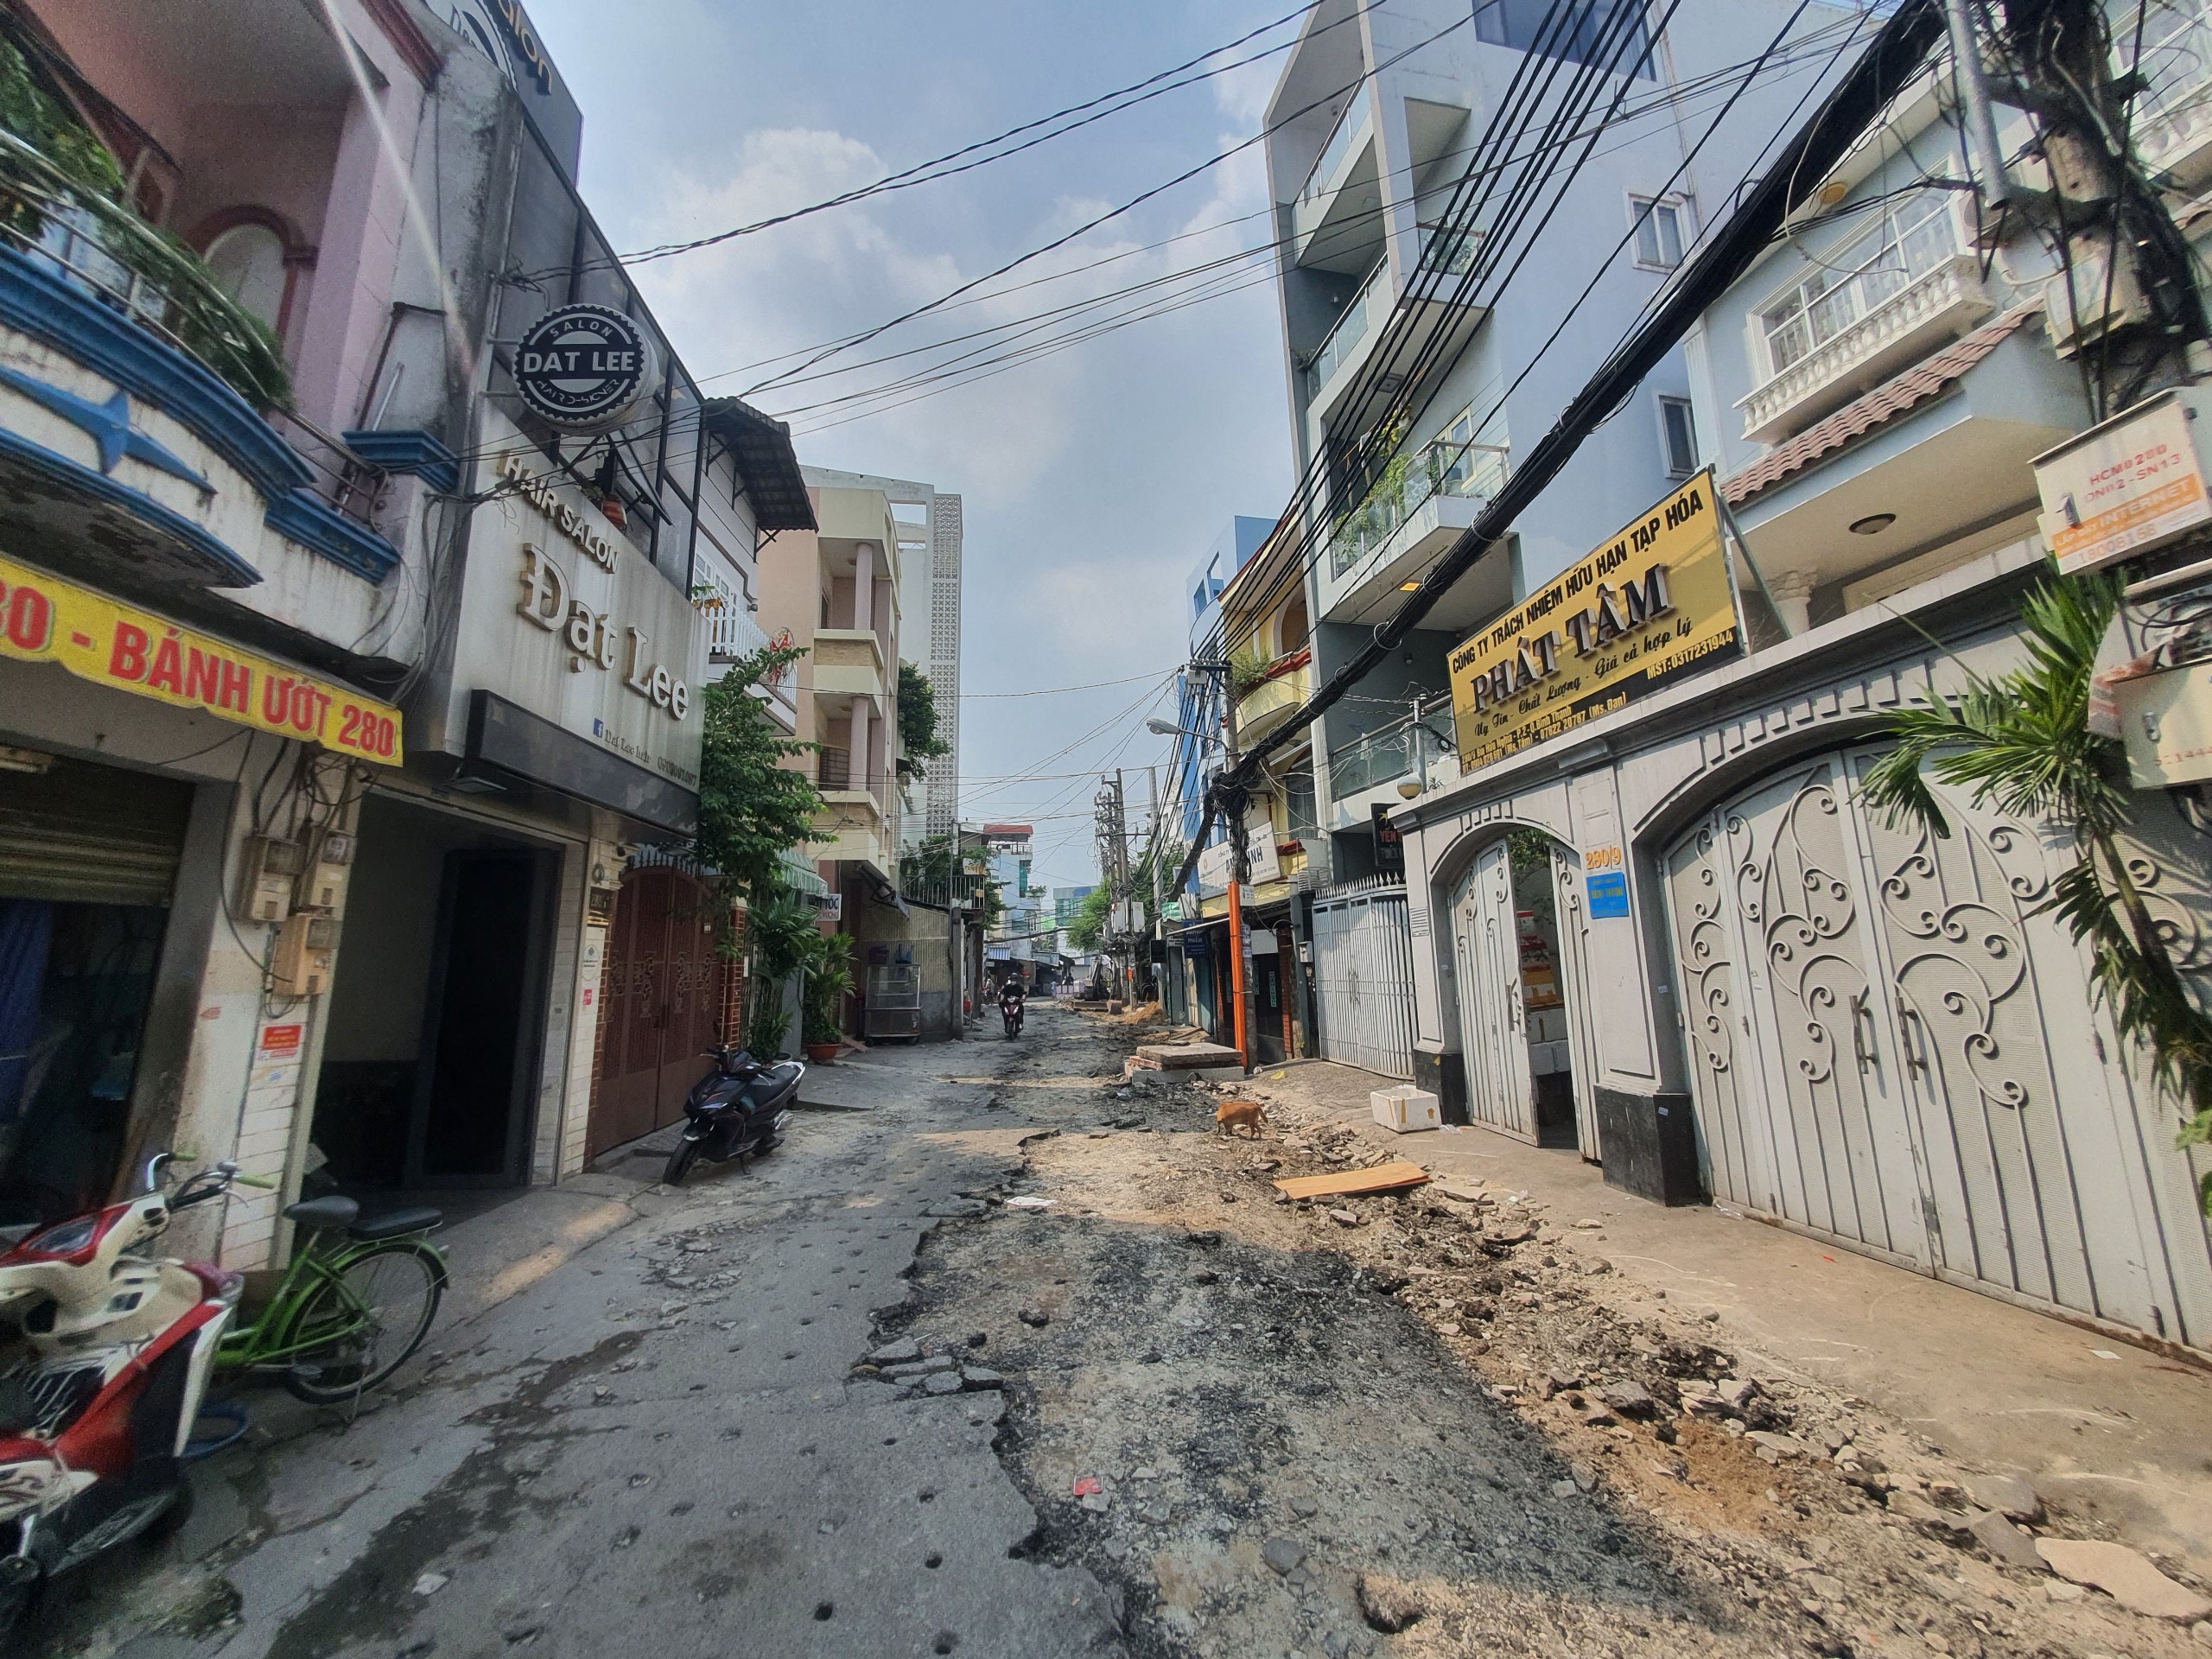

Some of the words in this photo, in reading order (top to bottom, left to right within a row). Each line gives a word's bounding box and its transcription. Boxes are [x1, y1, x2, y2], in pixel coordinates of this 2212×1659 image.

[523, 351, 581, 373] DAT
[592, 351, 636, 372] LEE
[550, 319, 613, 338] SALON
[501, 452, 559, 518] HAIR
[557, 504, 620, 574] SALON
[2099, 479, 2190, 526] INTERNET
[518, 543, 618, 672] Đạt
[624, 627, 690, 721] Lee
[1452, 645, 1476, 674] CÔNG
[1477, 636, 1489, 657] TY
[1491, 612, 1524, 647] TRÁCH
[1526, 585, 1563, 625] NHIỆM
[1566, 564, 1593, 599] HỮU
[1596, 540, 1628, 578] HẠN
[1630, 517, 1661, 553] TẠP
[1664, 489, 1704, 531] HÓA
[1471, 631, 1560, 715] PHÁT
[1566, 563, 1672, 658] TÂM
[108, 620, 252, 714] BÁNH
[262, 673, 333, 737] ƯỚT
[338, 704, 396, 758] 280
[1594, 654, 1618, 678] Giá
[1643, 632, 1672, 653] hợp
[1676, 616, 1693, 638] lý
